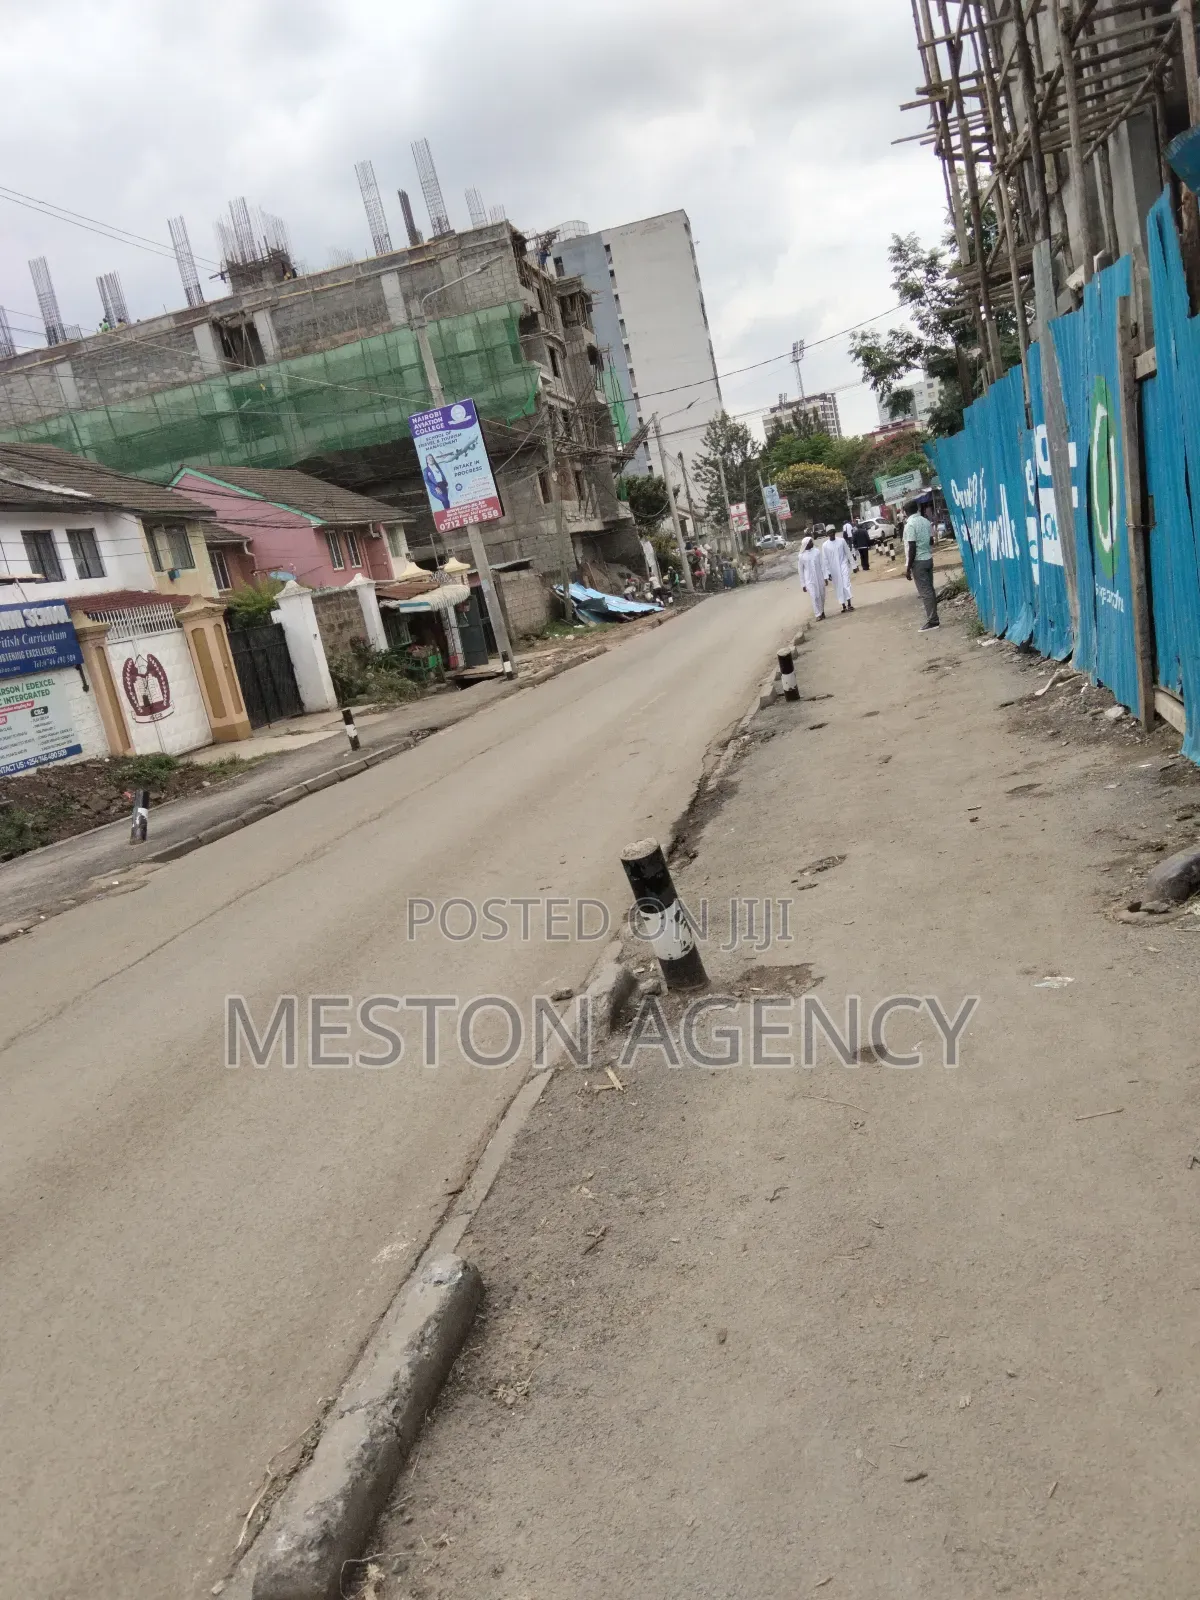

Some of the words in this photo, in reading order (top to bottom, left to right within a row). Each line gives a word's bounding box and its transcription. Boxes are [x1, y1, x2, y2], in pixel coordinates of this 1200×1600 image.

[412, 411, 442, 424] NAIROBI
[413, 417, 443, 430] AVIATION
[415, 423, 445, 435] COLLEGE
[418, 440, 436, 448] TRAVEL
[441, 433, 462, 442] TOURISM
[425, 432, 444, 441] SCHOOL
[425, 439, 458, 451] MANAGEMENT
[453, 462, 473, 471] INTAKE
[454, 466, 483, 477] PROGRESS
[439, 520, 460, 531] 0712
[463, 515, 480, 525] 555
[22, 630, 67, 645] Curriculum
[25, 646, 57, 659] EXCELLENCE
[25, 679, 55, 691] EDEXCEL
[4, 689, 50, 704] INTERGRATED
